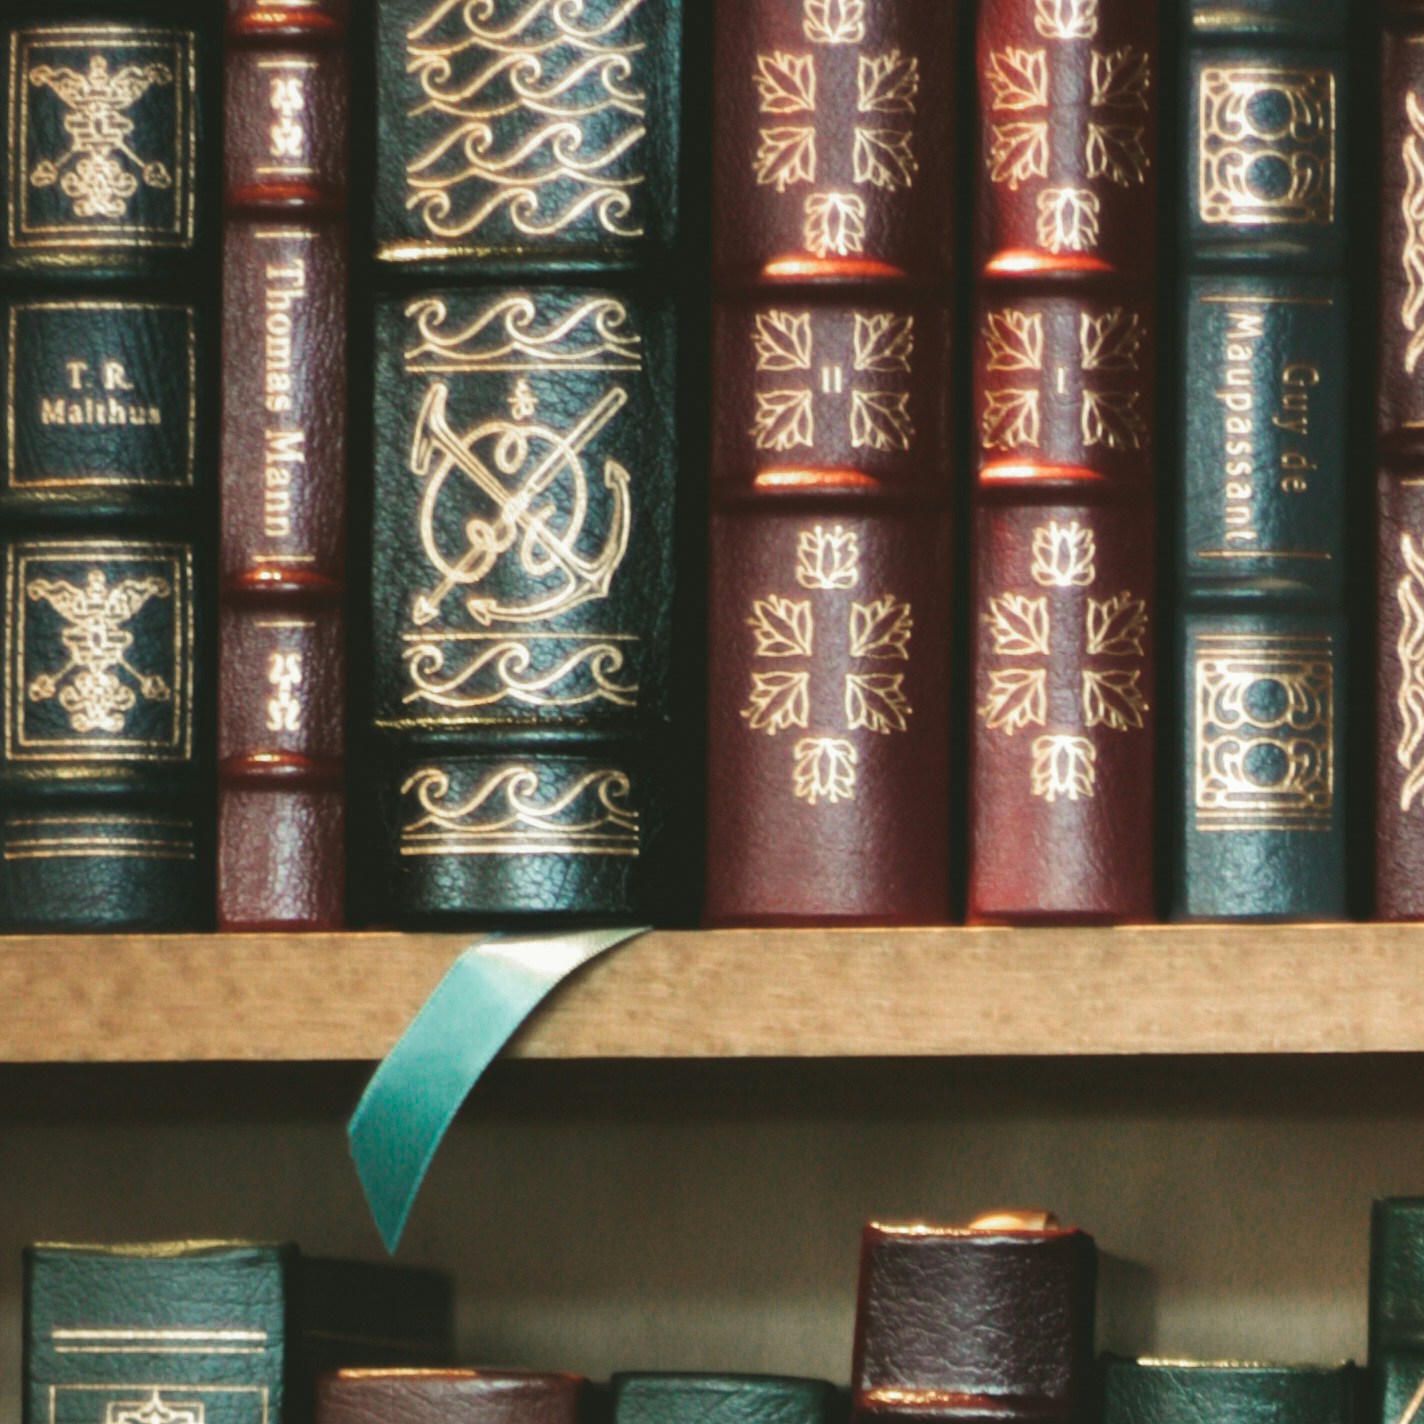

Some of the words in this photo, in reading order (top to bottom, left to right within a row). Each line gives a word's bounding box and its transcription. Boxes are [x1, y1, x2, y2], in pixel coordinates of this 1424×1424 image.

[264, 258, 305, 411] Thomas
[41, 397, 161, 425] Malthus
[1224, 313, 1263, 542] Maupassant
[1271, 364, 1319, 437] Guy
[264, 430, 305, 539] Mann
[1280, 451, 1318, 495] de
